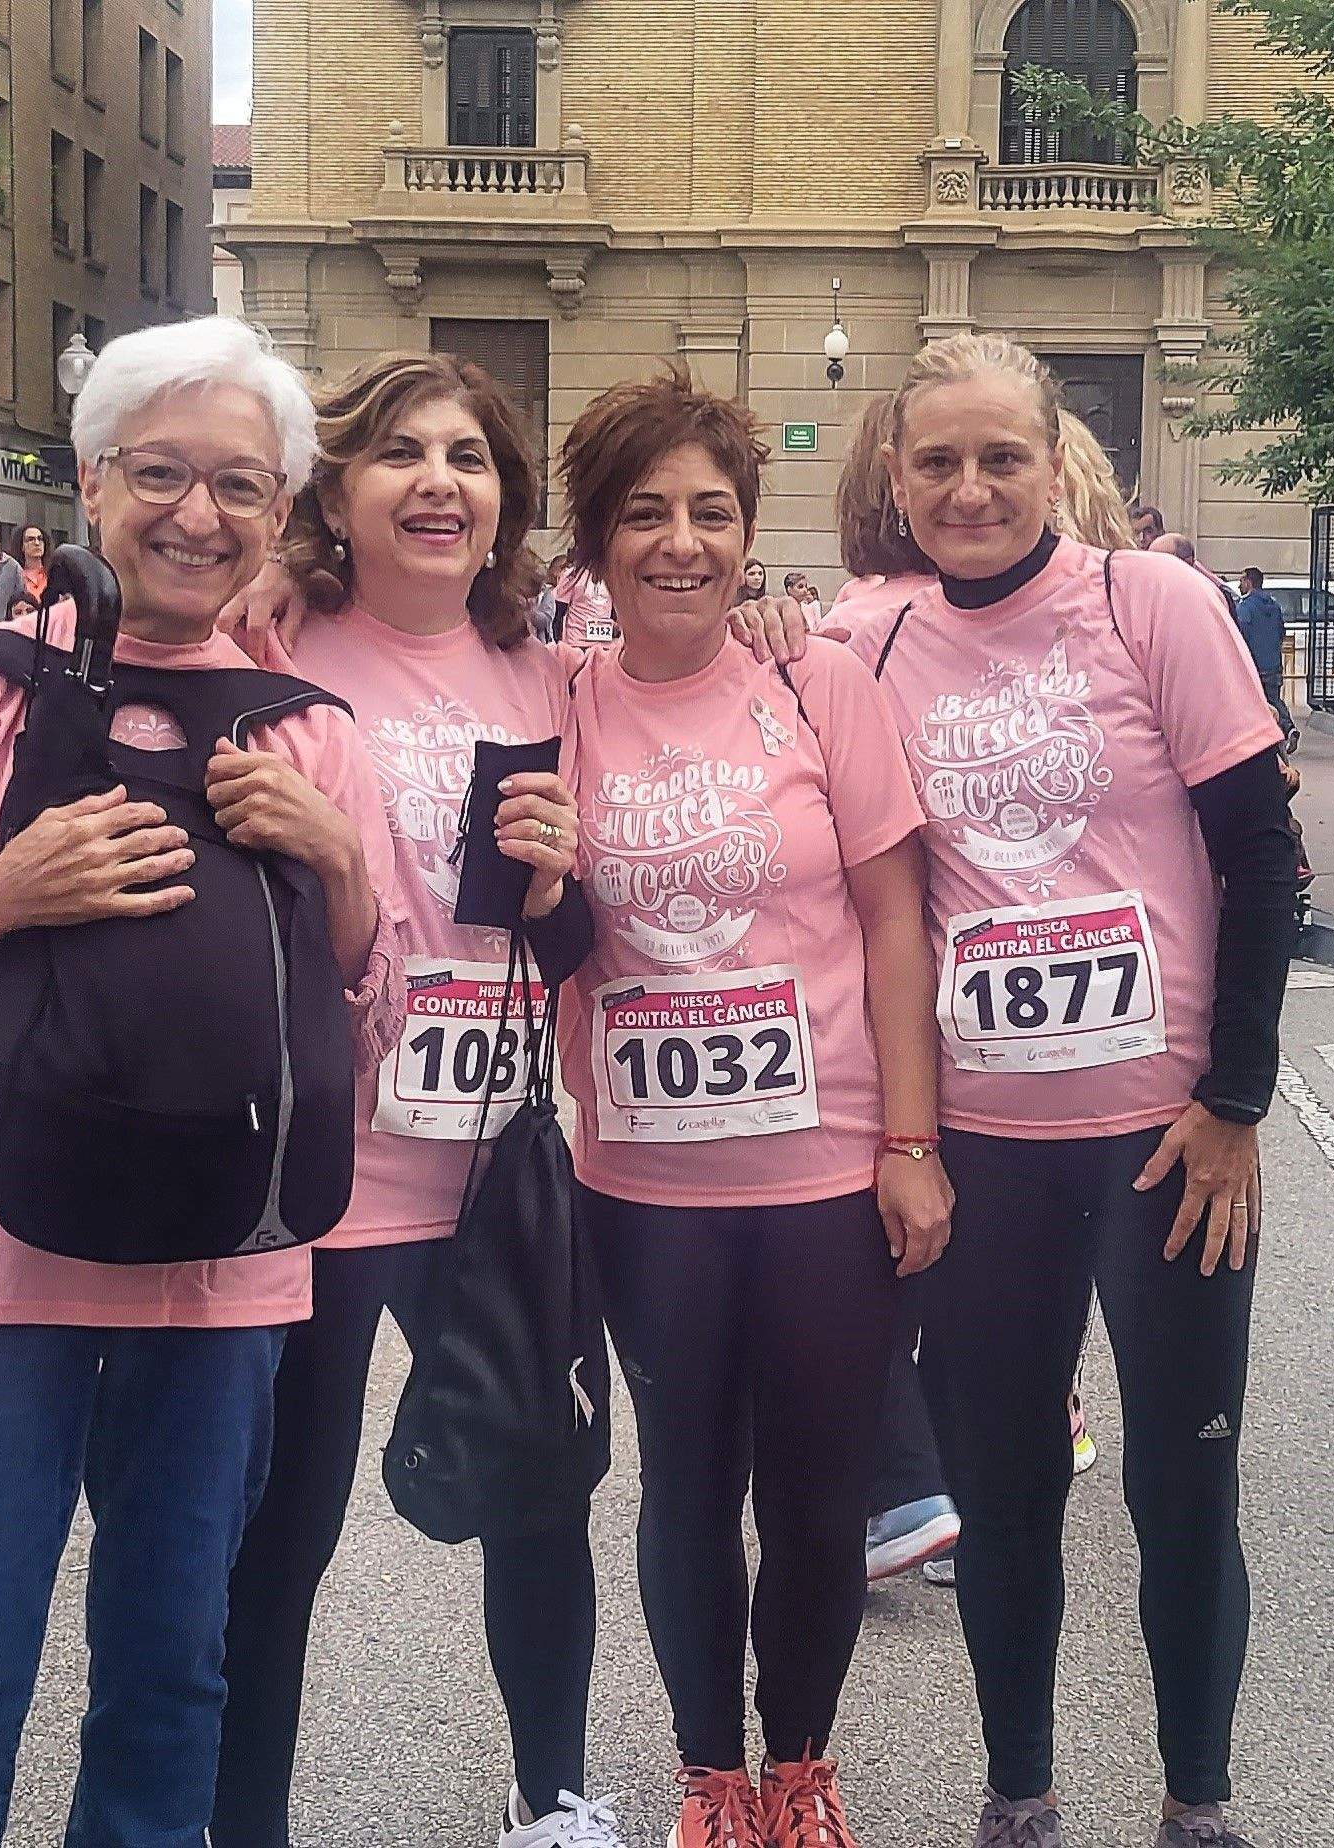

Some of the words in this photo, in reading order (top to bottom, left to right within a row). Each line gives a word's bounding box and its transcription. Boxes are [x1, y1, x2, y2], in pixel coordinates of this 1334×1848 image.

[589, 627, 611, 636] 2152
[1016, 920, 1070, 937] HUESCA
[963, 939, 1032, 961] CONTRA
[1035, 938, 1057, 954] EL
[1060, 925, 1135, 951] CÁNCER
[670, 994, 723, 1008] HUESCA
[961, 951, 1140, 1032] 1877
[413, 996, 489, 1017] CONTRA
[615, 1010, 684, 1027] CONTRA
[687, 1009, 708, 1026] EL
[713, 999, 788, 1023] CÁNCER
[613, 1027, 797, 1099] 1032
